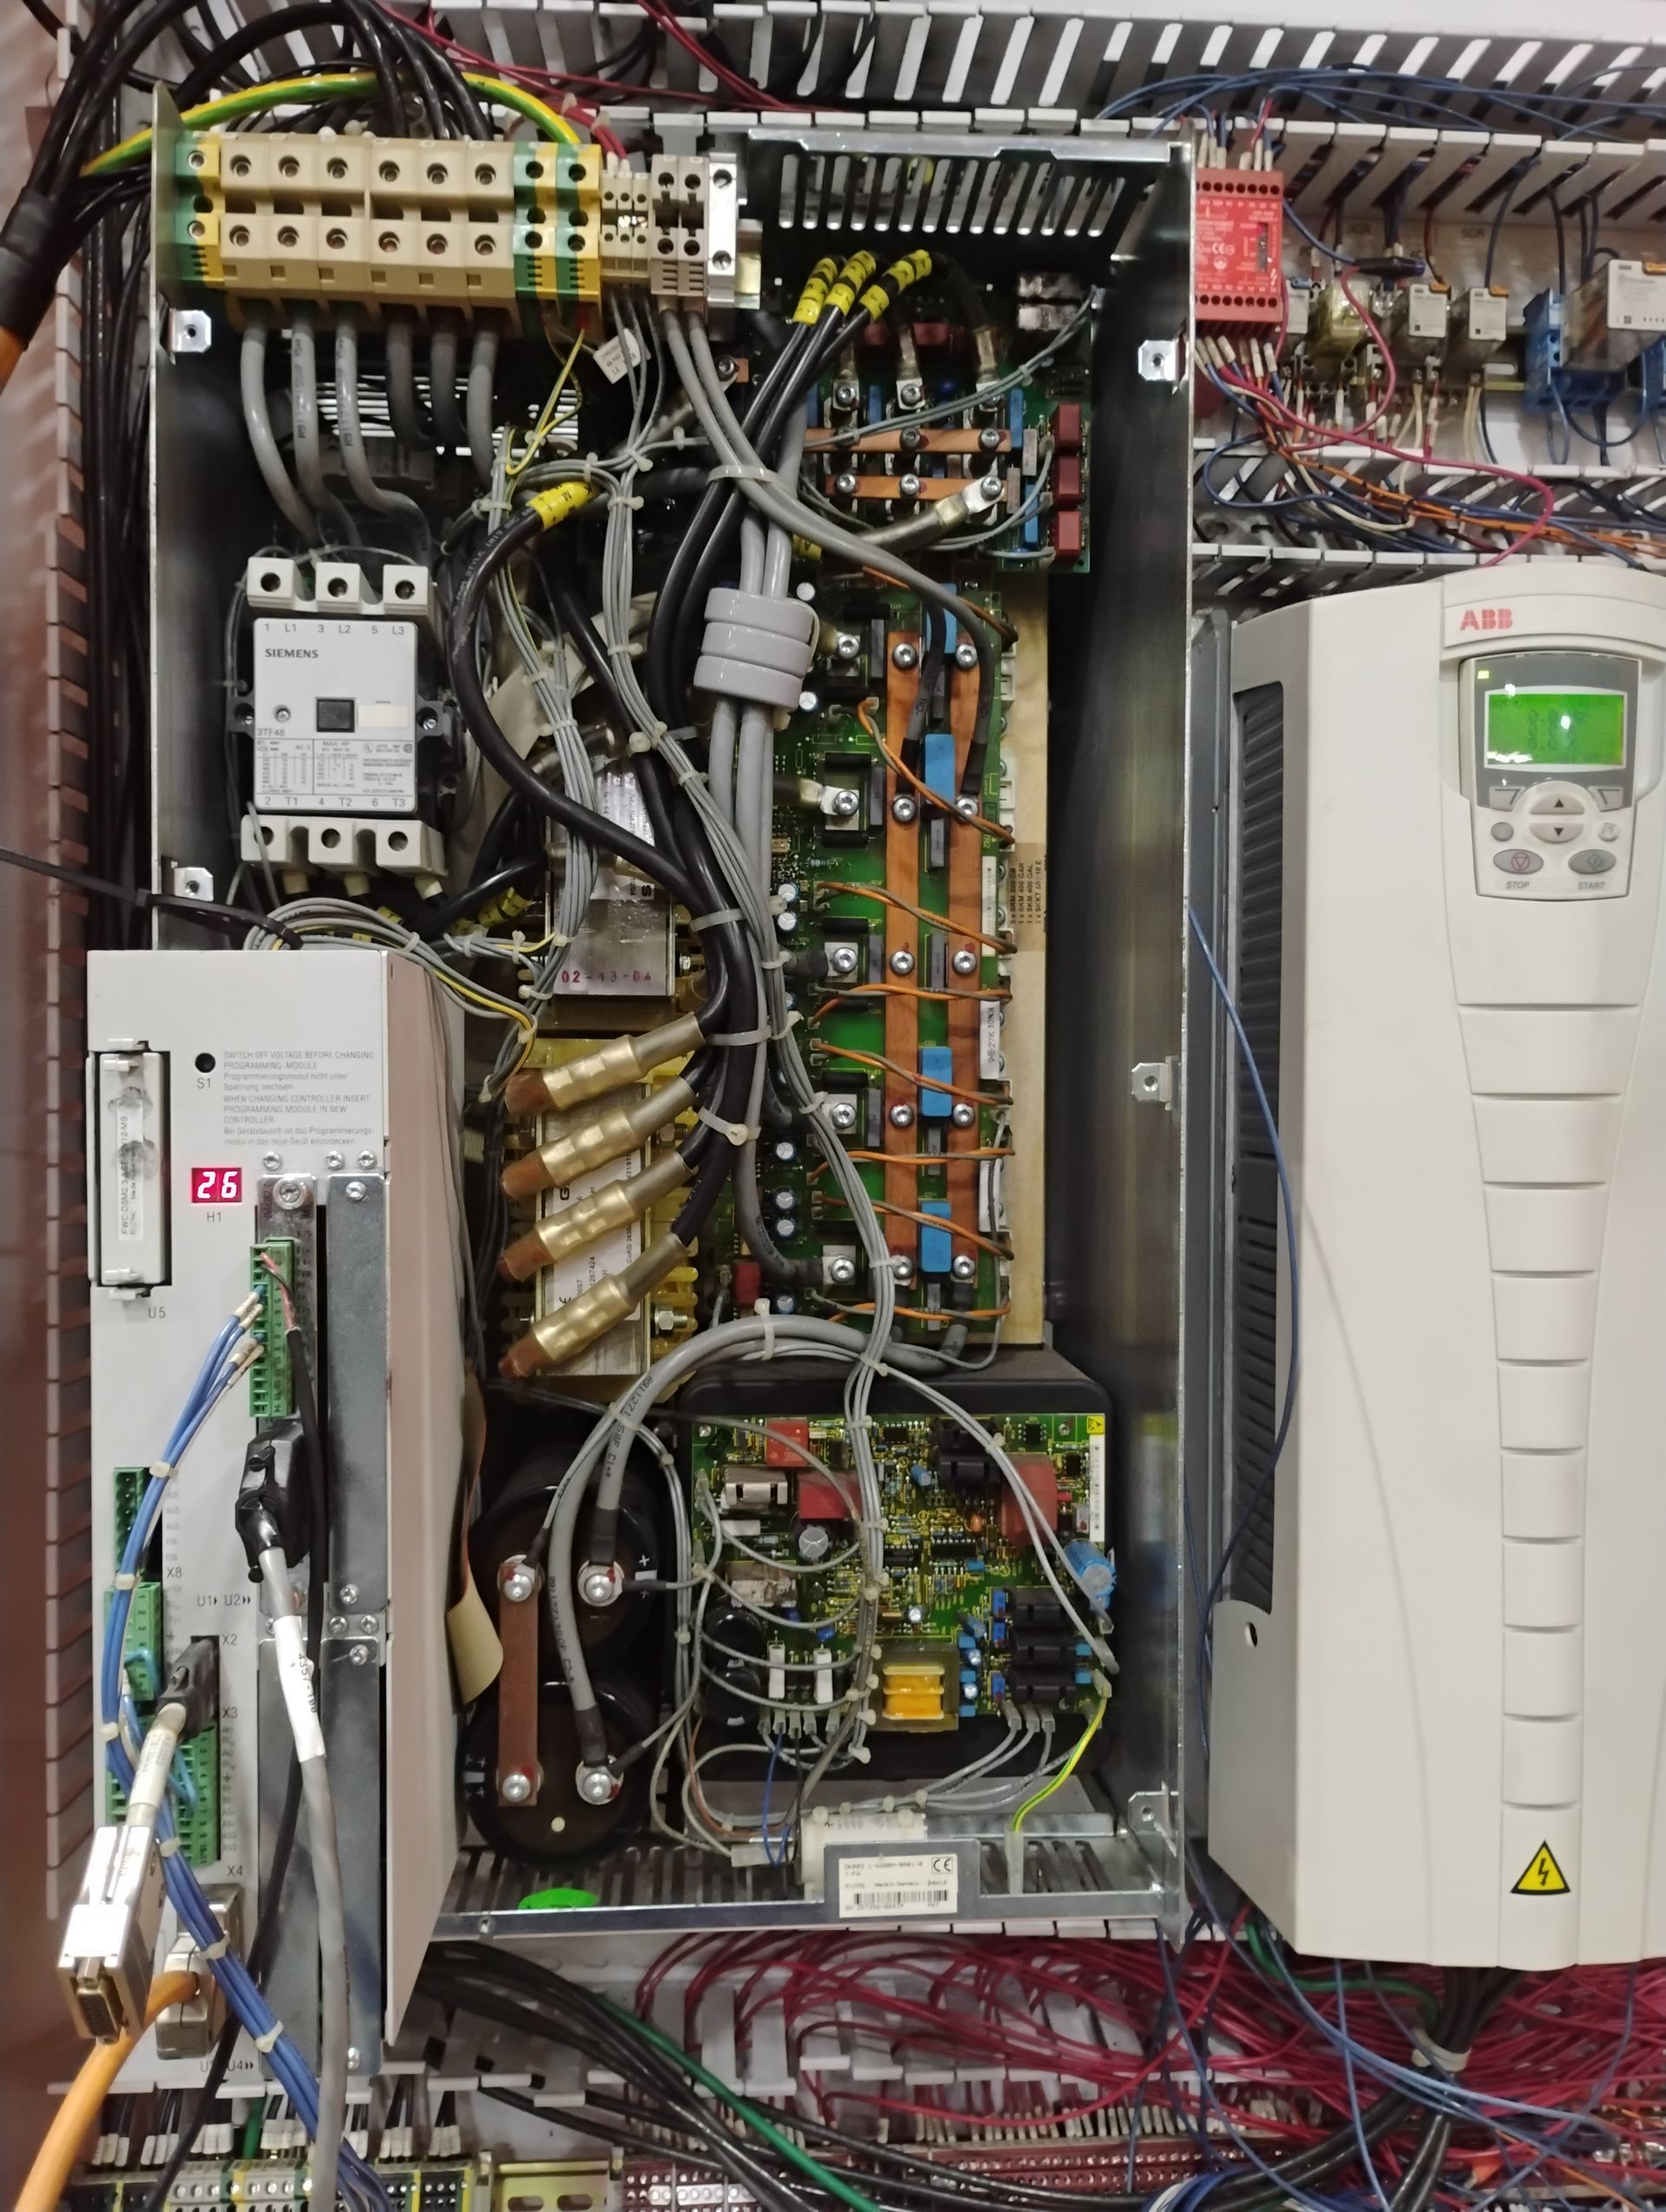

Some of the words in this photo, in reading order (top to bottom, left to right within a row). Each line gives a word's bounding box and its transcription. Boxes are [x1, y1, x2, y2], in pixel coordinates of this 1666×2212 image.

[1459, 608, 1513, 631] ABB
[265, 623, 270, 632] 1
[285, 624, 297, 632] L1
[318, 625, 325, 633] 3
[338, 625, 351, 634] L2
[371, 625, 377, 634] 5
[392, 626, 404, 635] L3
[265, 648, 318, 658] SIEMENS
[265, 796, 271, 806] 2
[285, 796, 298, 806] T1
[319, 797, 325, 806] 4
[338, 797, 352, 807] T2
[371, 798, 378, 807] 6
[392, 798, 405, 807] T3
[1505, 880, 1530, 890] STOP
[1577, 881, 1605, 890] START
[224, 1061, 281, 1070] PROGRAMMING
[286, 1061, 317, 1070] MODULE
[196, 1078, 211, 1089] S1
[196, 1170, 239, 1199] 26
[207, 1212, 221, 1222] H1
[148, 1306, 166, 1319] U5
[166, 1567, 182, 1578] X8
[197, 1595, 214, 1607] U1
[224, 1595, 241, 1606] U2
[221, 1635, 238, 1646] X2
[222, 1708, 238, 1718] X3
[227, 1865, 244, 1877] X4
[227, 2059, 244, 2072] U4
